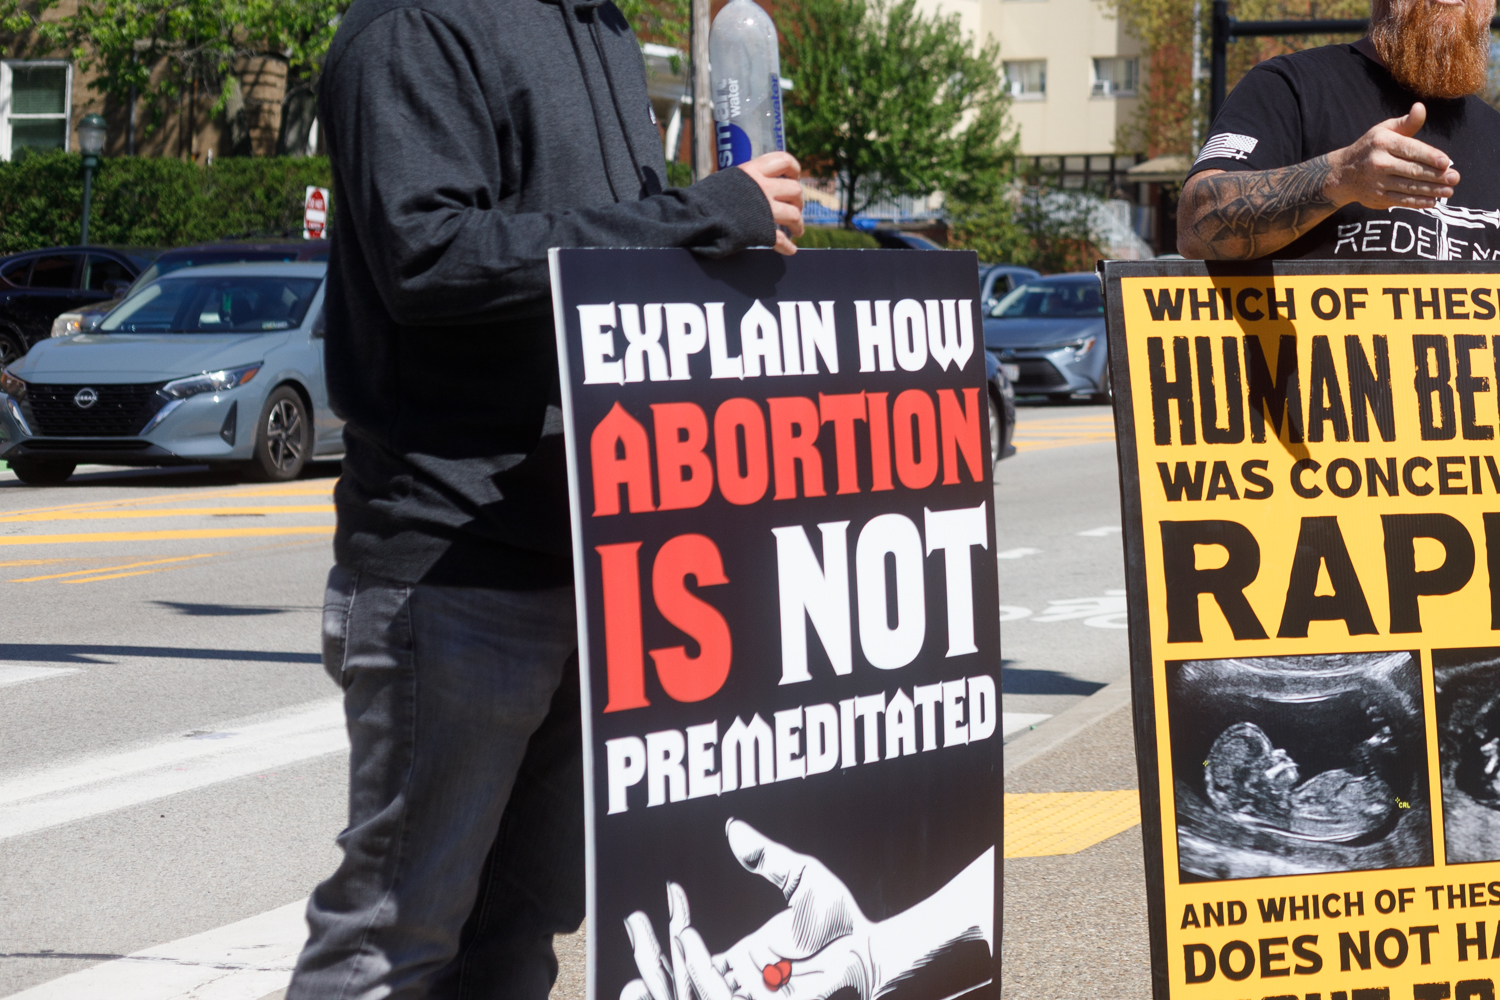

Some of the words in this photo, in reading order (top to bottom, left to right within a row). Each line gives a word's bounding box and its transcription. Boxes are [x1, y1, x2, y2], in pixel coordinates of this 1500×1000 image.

[728, 78, 741, 118] water
[771, 75, 784, 152] artwater
[577, 299, 839, 386] EXPLAIN
[854, 299, 975, 372] HOW
[1143, 288, 1297, 322] WHICH
[1311, 287, 1369, 321] OF
[1147, 334, 1396, 446] HUMAN
[590, 388, 984, 517] ABORTION
[1156, 460, 1274, 502] WAS
[595, 533, 733, 714] IS
[771, 501, 989, 686] NOT
[605, 675, 997, 815] PREMEDITATED
[1180, 902, 1248, 930] AND
[1257, 890, 1365, 923] WHICH
[1374, 887, 1415, 914] OF
[1183, 934, 1324, 985] DOES
[1338, 925, 1440, 972] NOT
